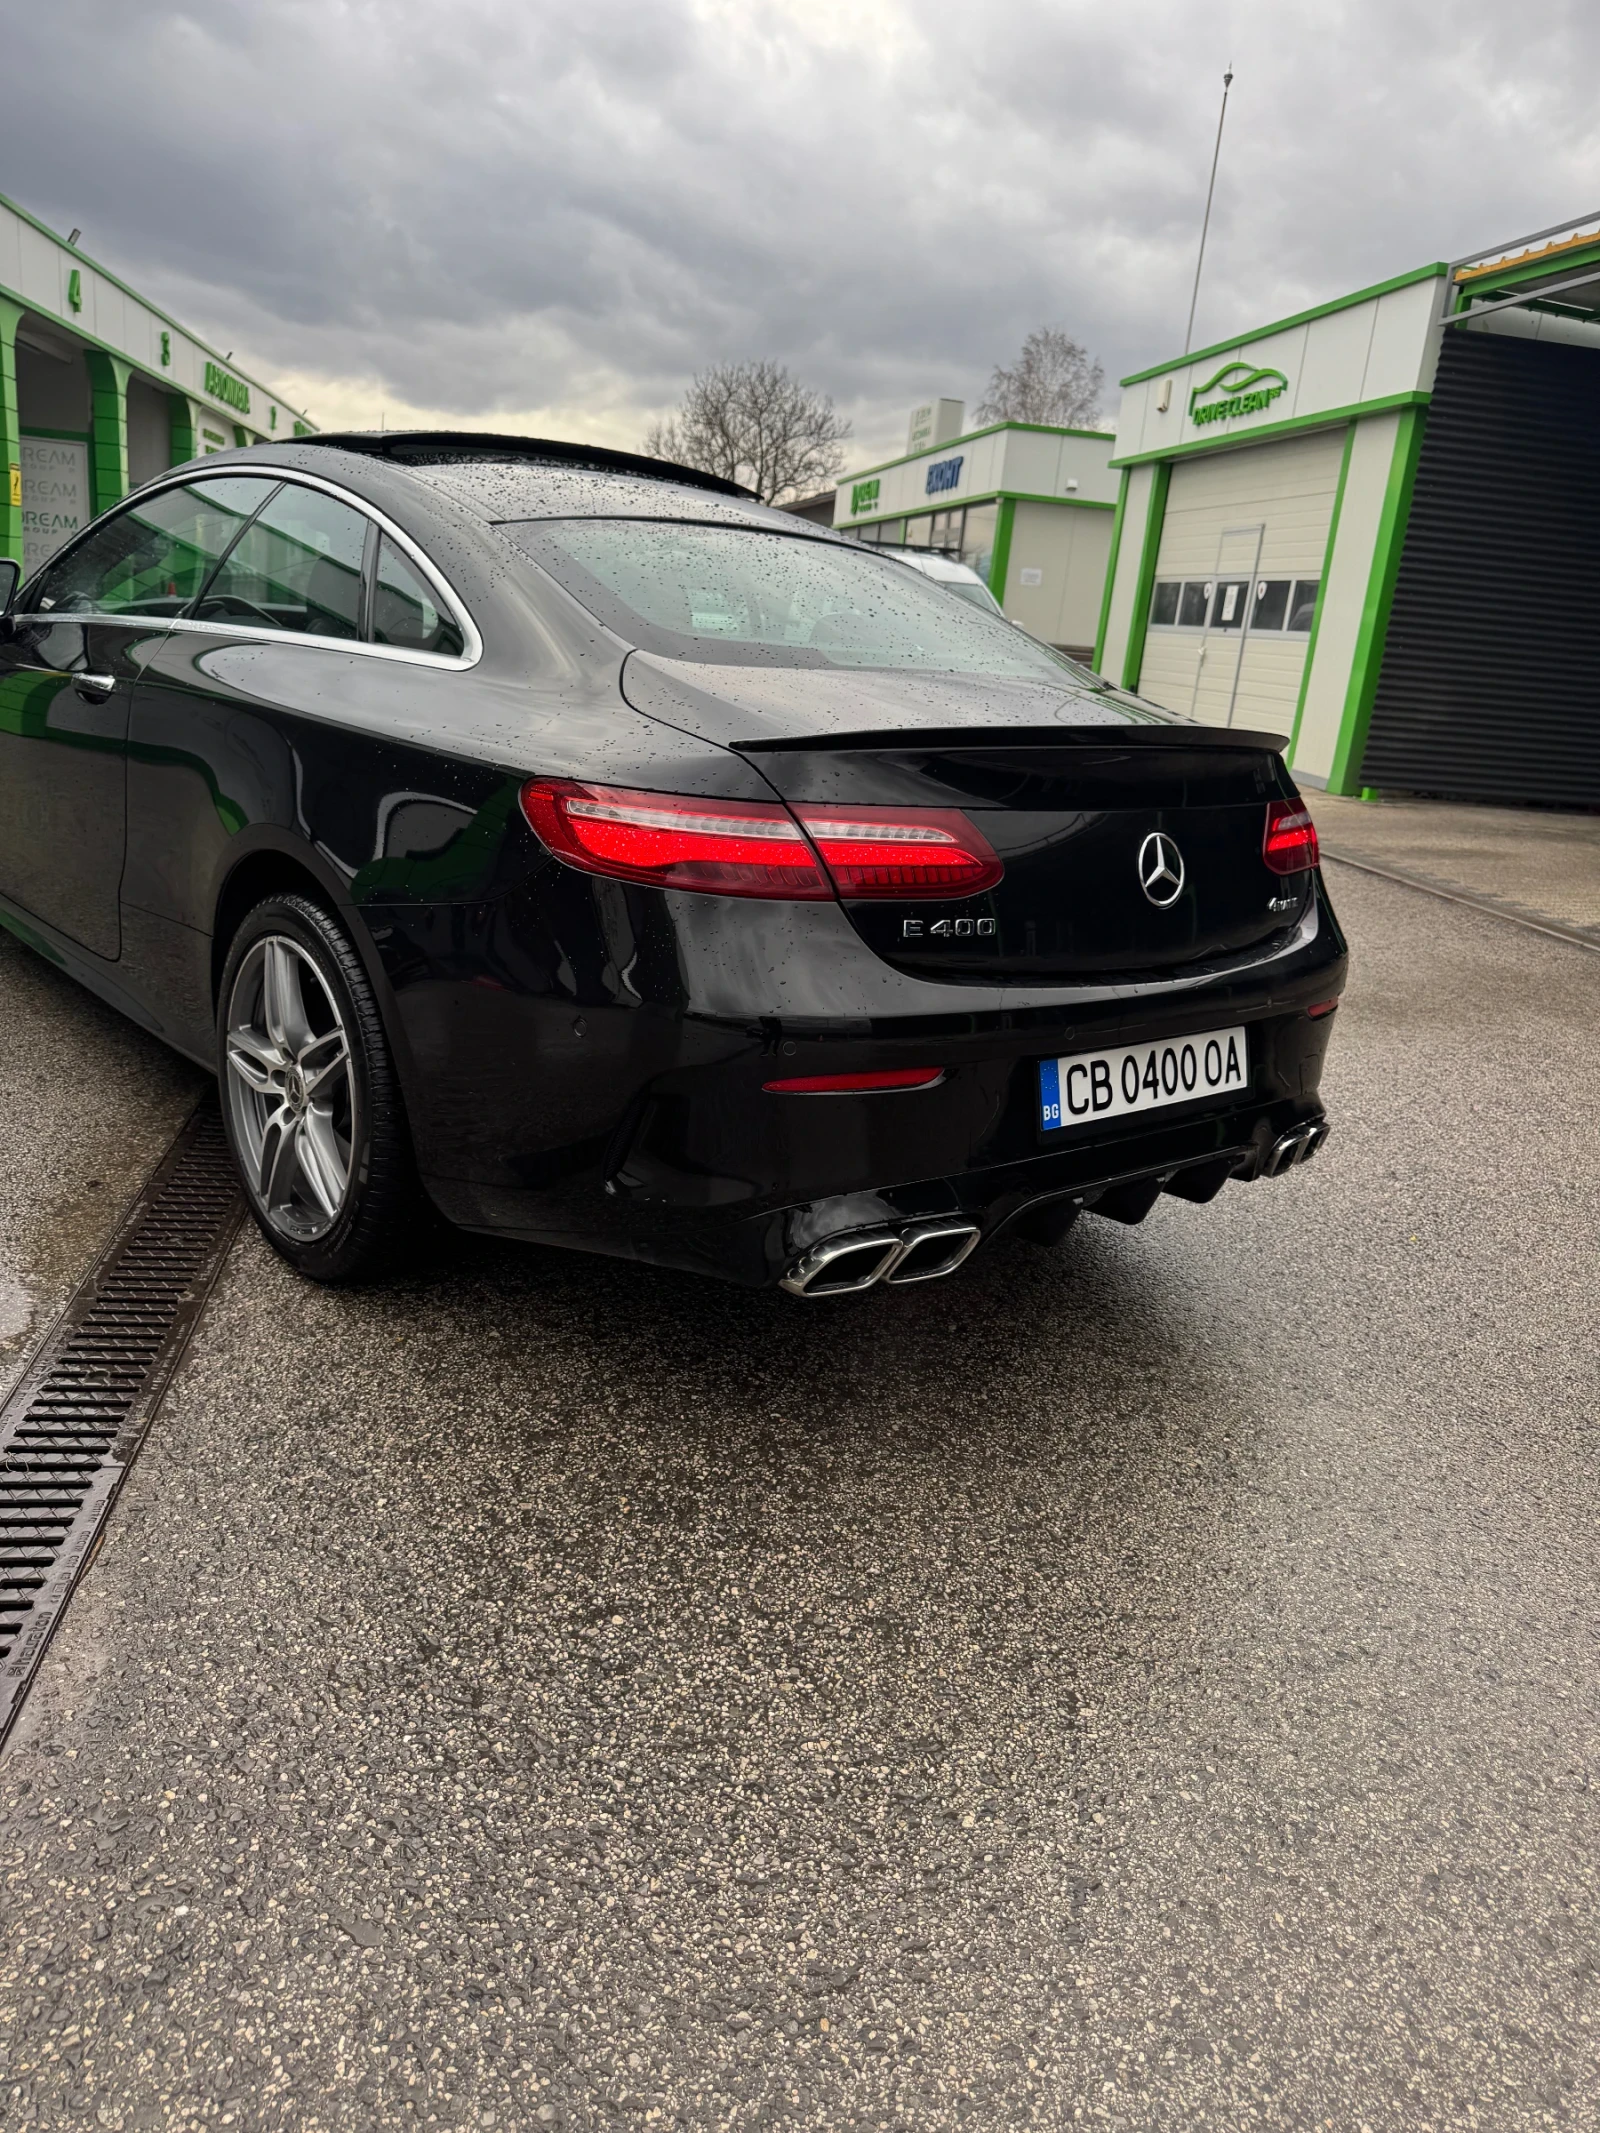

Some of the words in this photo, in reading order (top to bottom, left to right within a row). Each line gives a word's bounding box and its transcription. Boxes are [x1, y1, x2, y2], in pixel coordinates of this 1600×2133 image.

[68, 269, 81, 313] 4
[161, 331, 170, 366] 3
[22, 446, 76, 466] REAM
[22, 478, 77, 497] REAM
[21, 510, 78, 530] REAM
[903, 919, 924, 937] E
[930, 918, 995, 937] 400
[1066, 1059, 1113, 1115] CB
[1121, 1044, 1197, 1104] 0400
[1204, 1035, 1241, 1087] OA
[1043, 1103, 1059, 1121] BG
